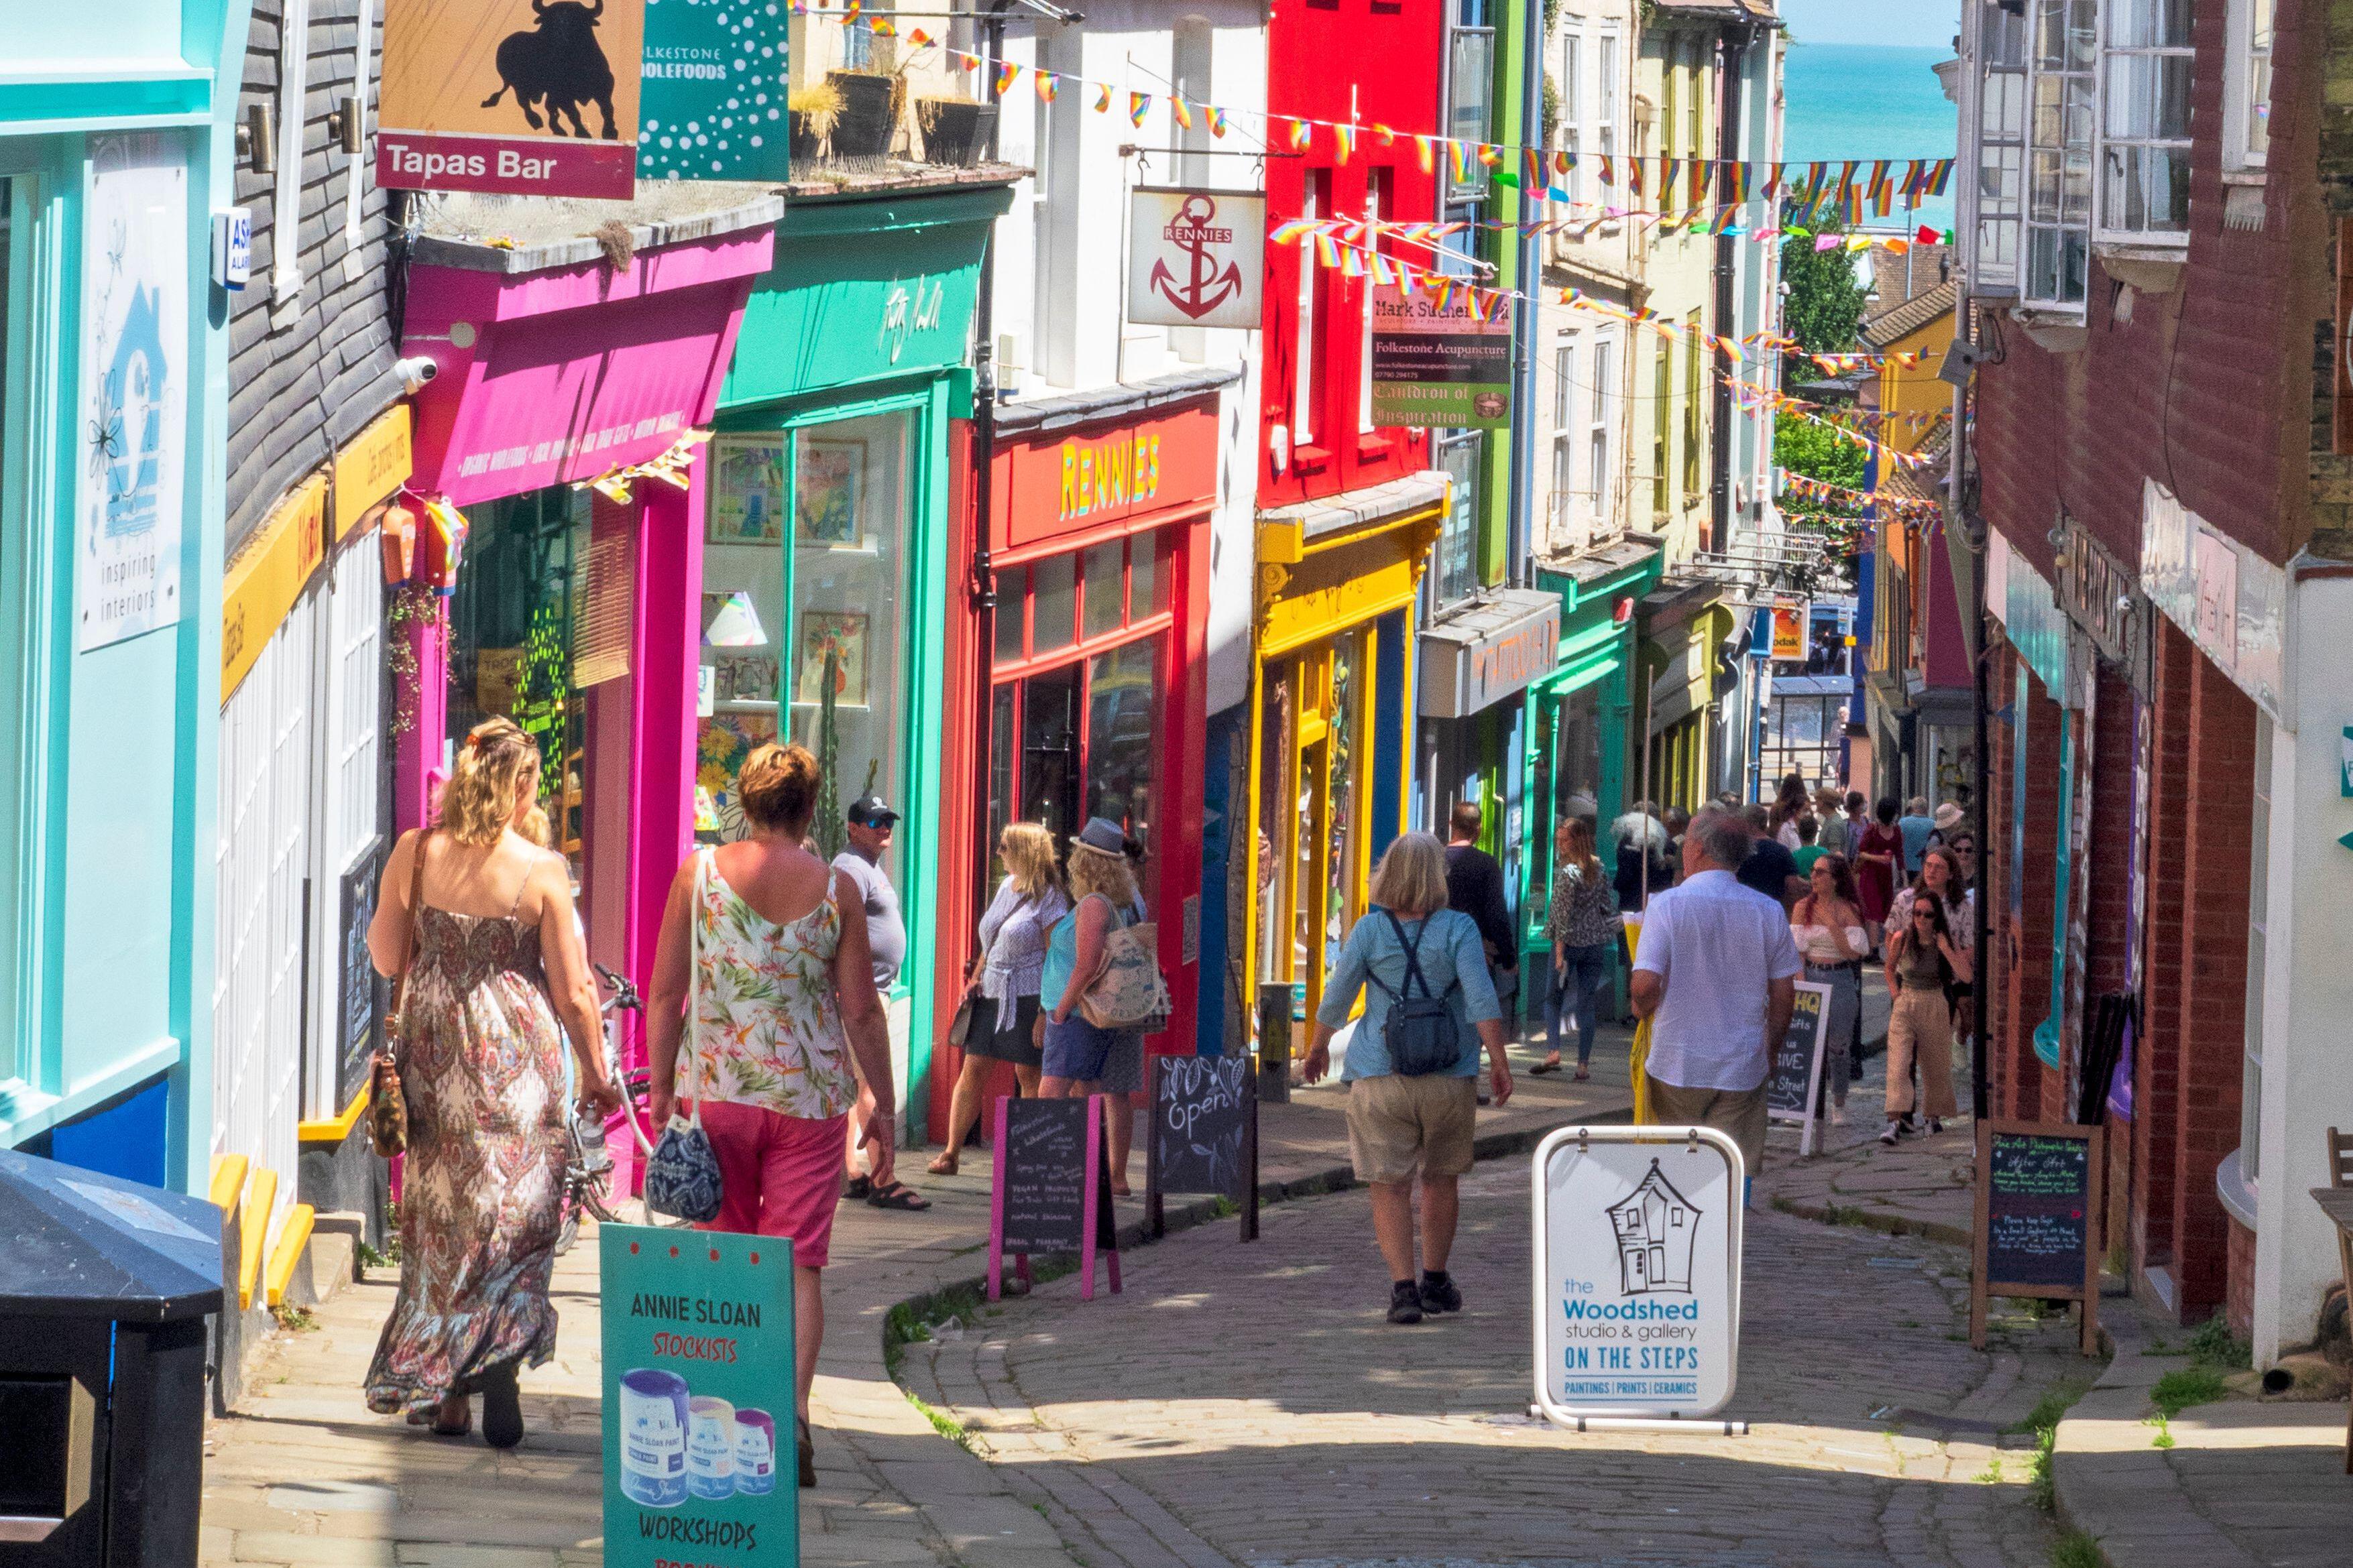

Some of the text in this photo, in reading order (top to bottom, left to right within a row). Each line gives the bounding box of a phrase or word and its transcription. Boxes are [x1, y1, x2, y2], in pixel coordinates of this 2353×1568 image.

[642, 46, 721, 60] LKESTONE
[386, 144, 557, 179] Tapas Bar
[1164, 228, 1232, 242] RENNIES
[1375, 301, 1414, 317] Mark
[1375, 341, 1507, 358] Folkestone Acupuncture
[1374, 385, 1468, 400] Cauldron of
[1375, 408, 1467, 424] Inspiration
[1059, 434, 1159, 522] RENNIES
[101, 552, 155, 587] inspiring
[101, 589, 155, 622] interiors
[1773, 638, 1798, 647] odak
[1794, 991, 1821, 1015] HQ
[1786, 1040, 1797, 1048] us
[1777, 1075, 1806, 1093] Street
[1168, 1093, 1228, 1140] Open
[1564, 1278, 1594, 1294] the
[630, 1292, 761, 1328] ANNIE SLOAN
[1563, 1299, 1698, 1320] Woodshed
[1566, 1323, 1697, 1341] studio & gallery
[652, 1331, 738, 1364] STOCKISTS
[1565, 1346, 1698, 1370] ON THE STEPS
[1564, 1382, 1697, 1394] PAINTINGS PRINTS CERAMICS
[639, 1512, 757, 1551] WORKSHOPS
